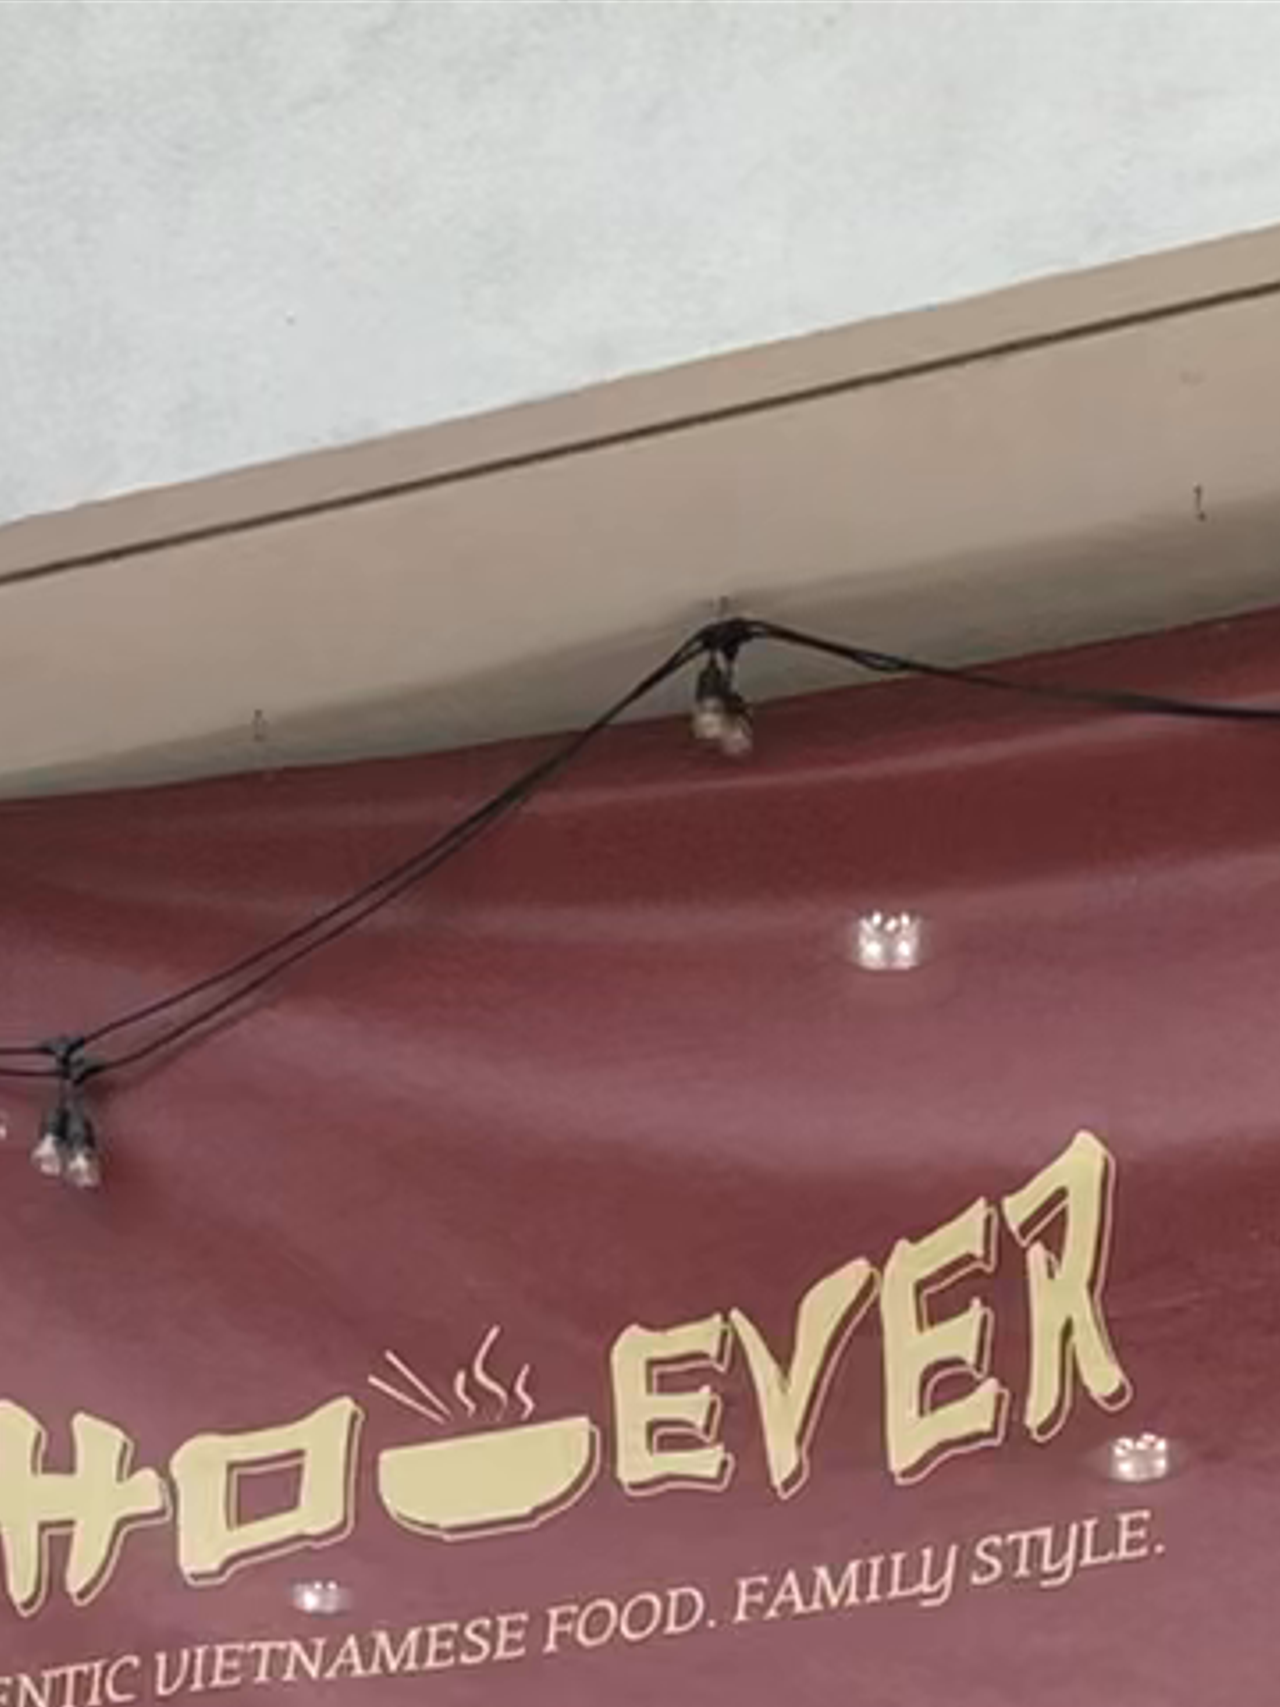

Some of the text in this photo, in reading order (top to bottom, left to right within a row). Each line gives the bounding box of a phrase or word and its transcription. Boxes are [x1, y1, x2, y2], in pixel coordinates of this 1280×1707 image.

[153, 1613, 529, 1698] VIETNAMESE
[542, 1587, 717, 1653] FOOD.
[732, 1543, 959, 1623] FAMILY
[970, 1510, 1166, 1587] STYLE.
